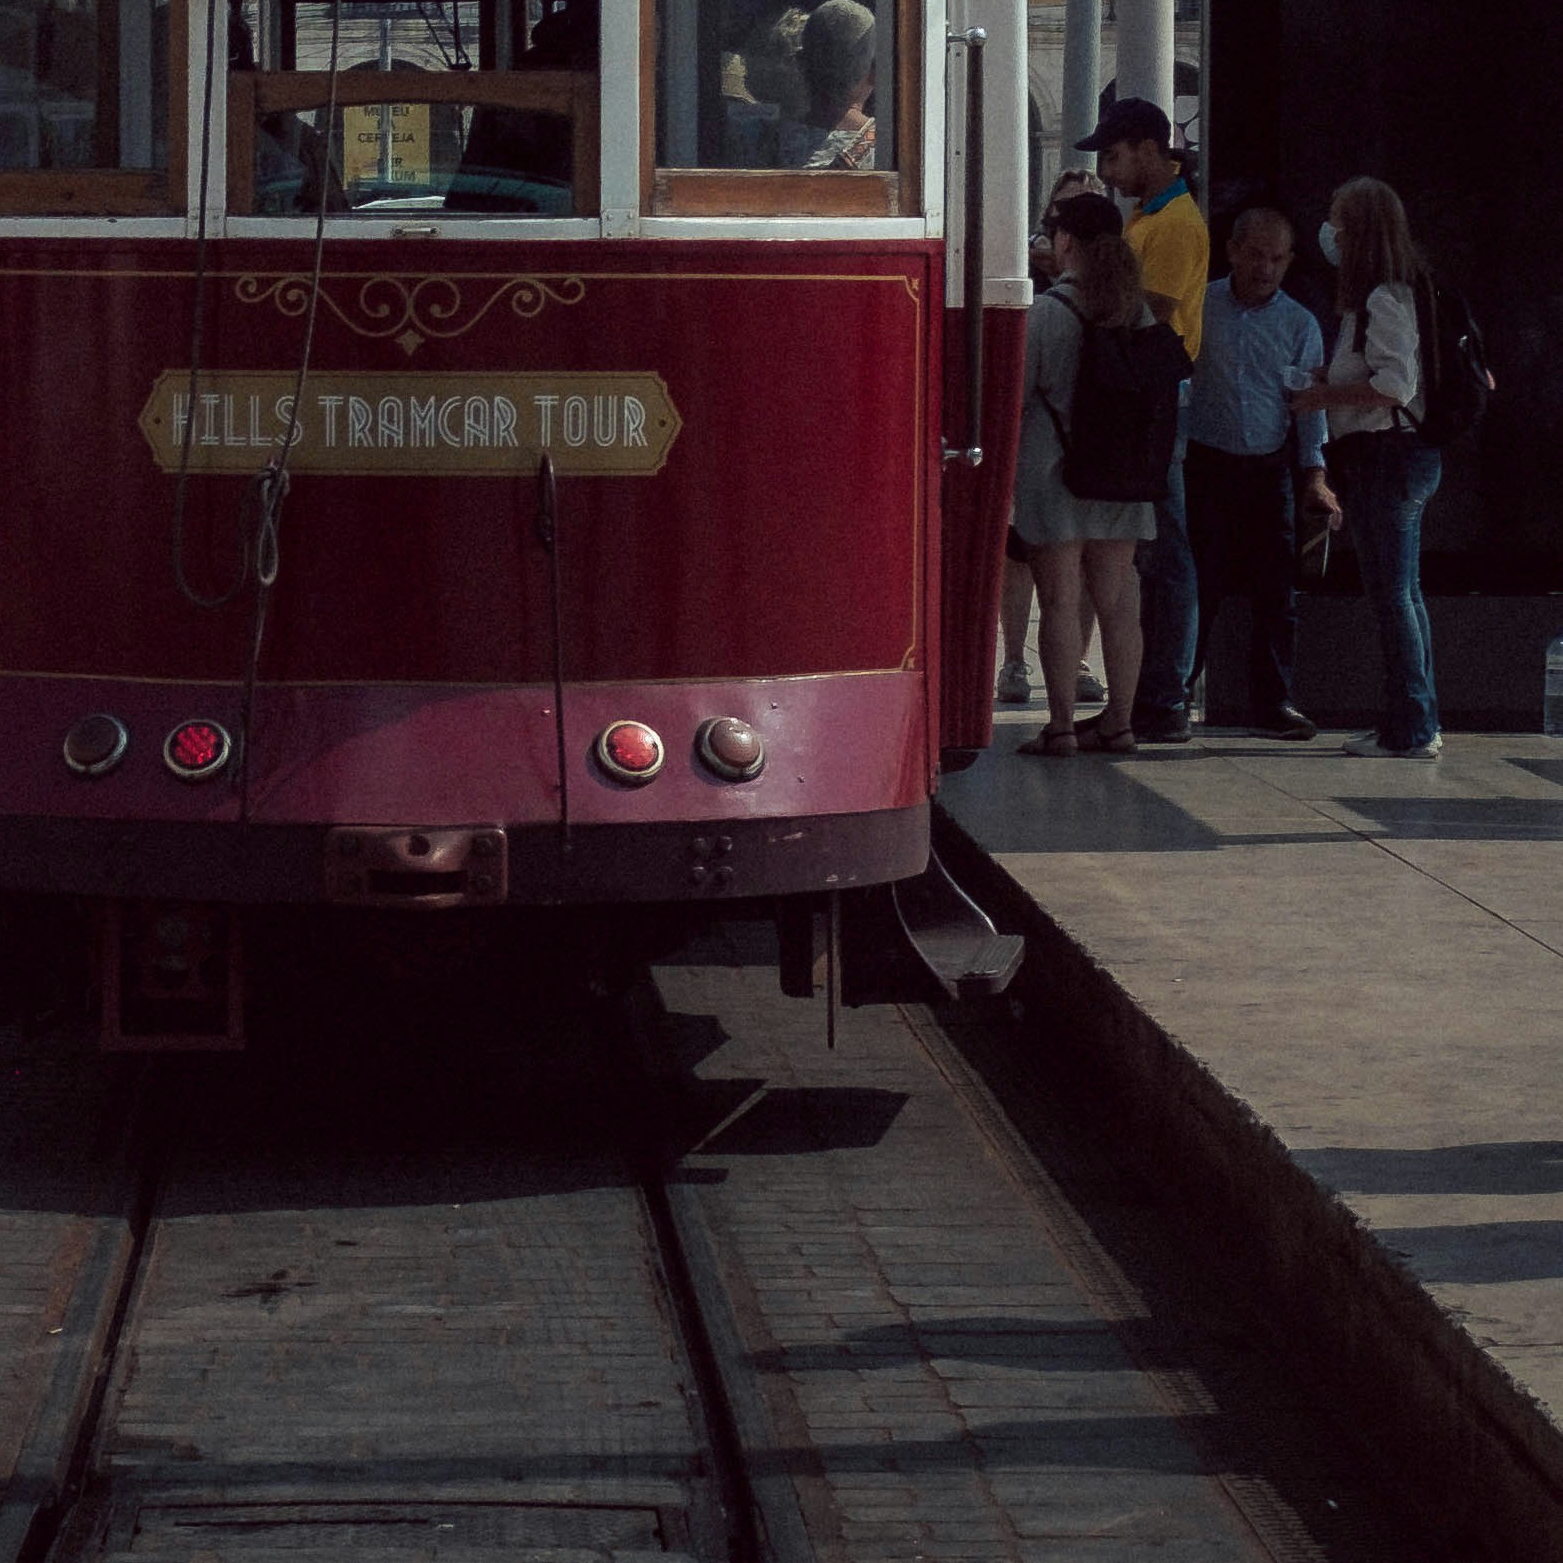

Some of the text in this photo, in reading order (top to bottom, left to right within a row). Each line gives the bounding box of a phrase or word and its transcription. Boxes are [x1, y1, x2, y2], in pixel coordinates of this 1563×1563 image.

[172, 393, 649, 448] HILLS TRAMCAR TOUR
